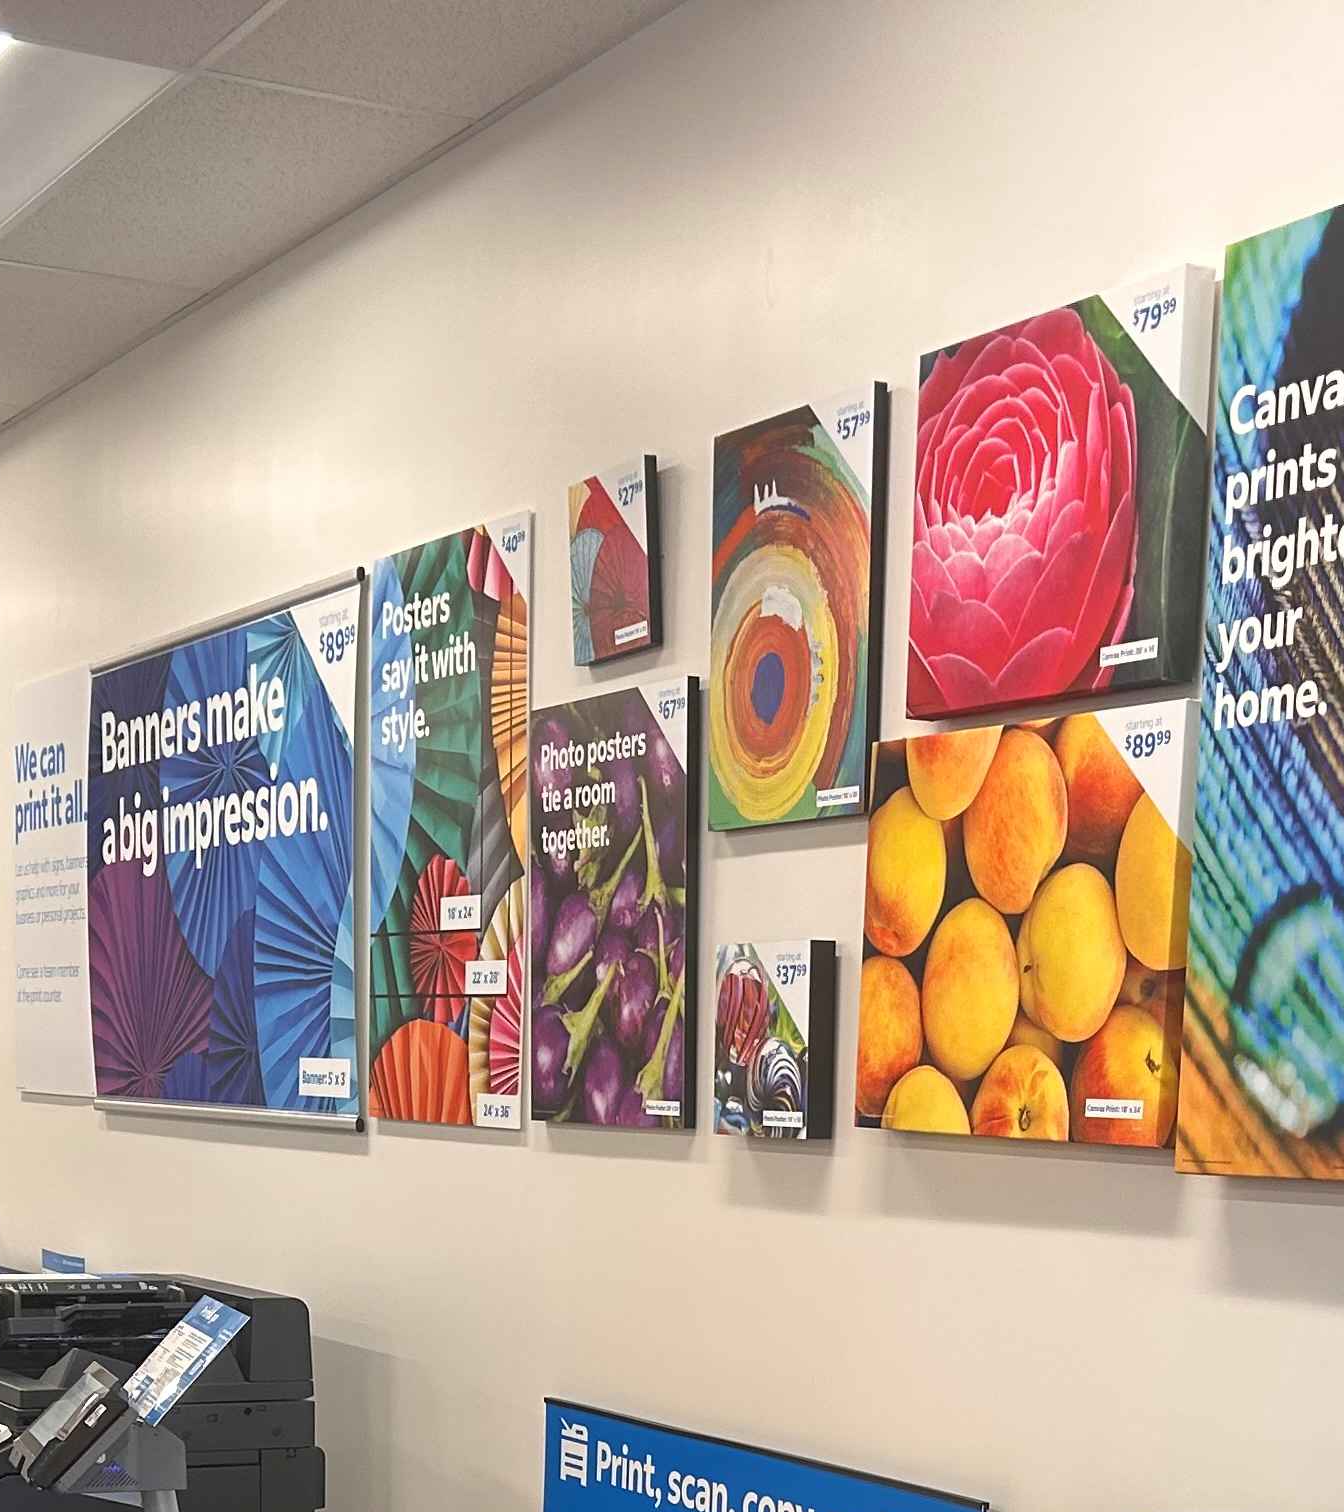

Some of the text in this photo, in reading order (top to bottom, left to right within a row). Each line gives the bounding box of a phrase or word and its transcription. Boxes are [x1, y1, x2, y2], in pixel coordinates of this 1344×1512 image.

[1224, 443, 1337, 524] prints
[382, 592, 450, 640] Posters
[1215, 605, 1303, 674] your
[382, 631, 476, 699] say it with
[101, 664, 285, 773] Banners make
[381, 700, 429, 752] style.
[1213, 679, 1327, 732] home.
[15, 742, 65, 783] We can
[541, 732, 646, 773] Photo posters
[15, 779, 88, 844] print it all.
[102, 762, 328, 877] a big impression.
[541, 781, 616, 813] tie a room
[541, 819, 610, 859] together.
[596, 1440, 661, 1509] Print,
